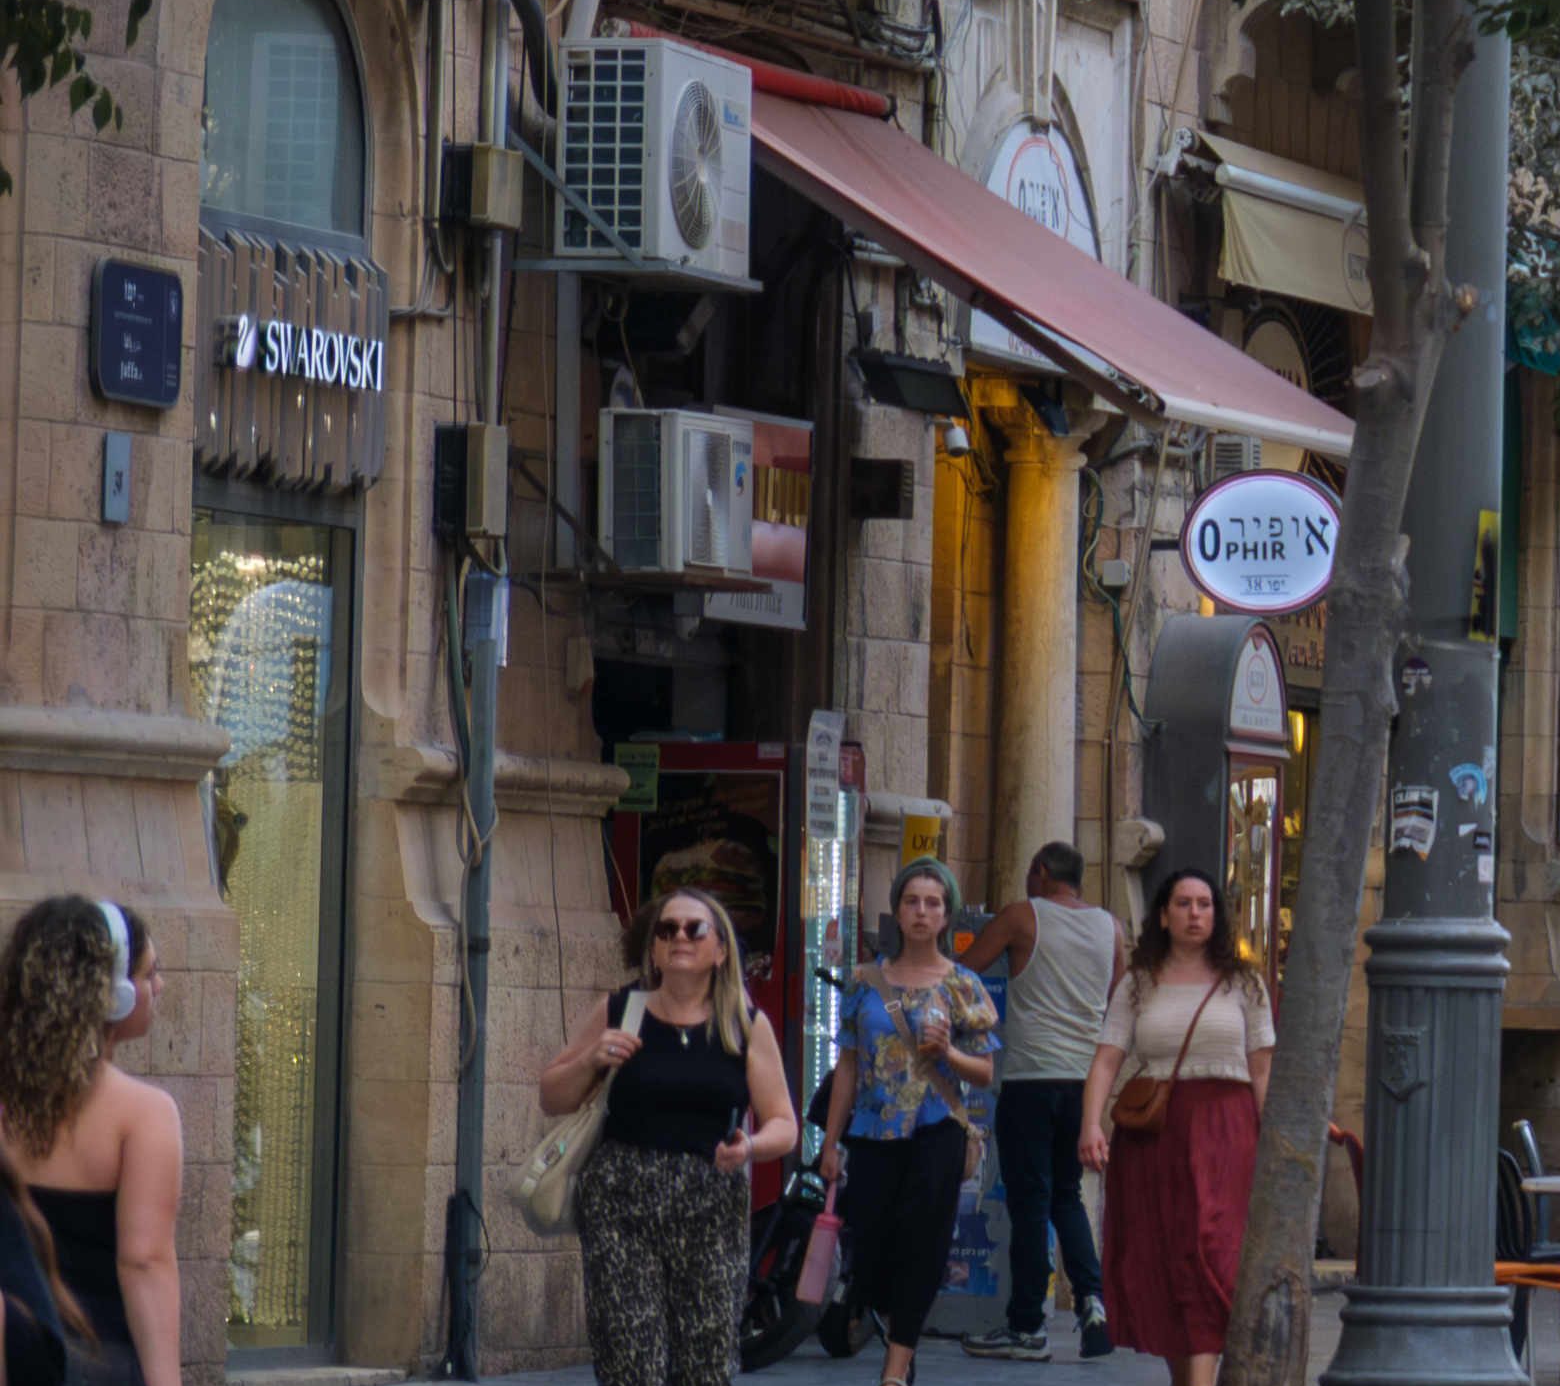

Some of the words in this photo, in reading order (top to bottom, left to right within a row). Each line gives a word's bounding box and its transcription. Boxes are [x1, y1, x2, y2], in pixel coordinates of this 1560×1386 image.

[265, 319, 384, 392] SWAROVSKI
[119, 361, 139, 381] Jaffa
[1198, 518, 1286, 562] OPHIR
[1229, 515, 1330, 556] אופיר
[1245, 577, 1262, 592] 38
[1267, 579, 1286, 592] יפו
